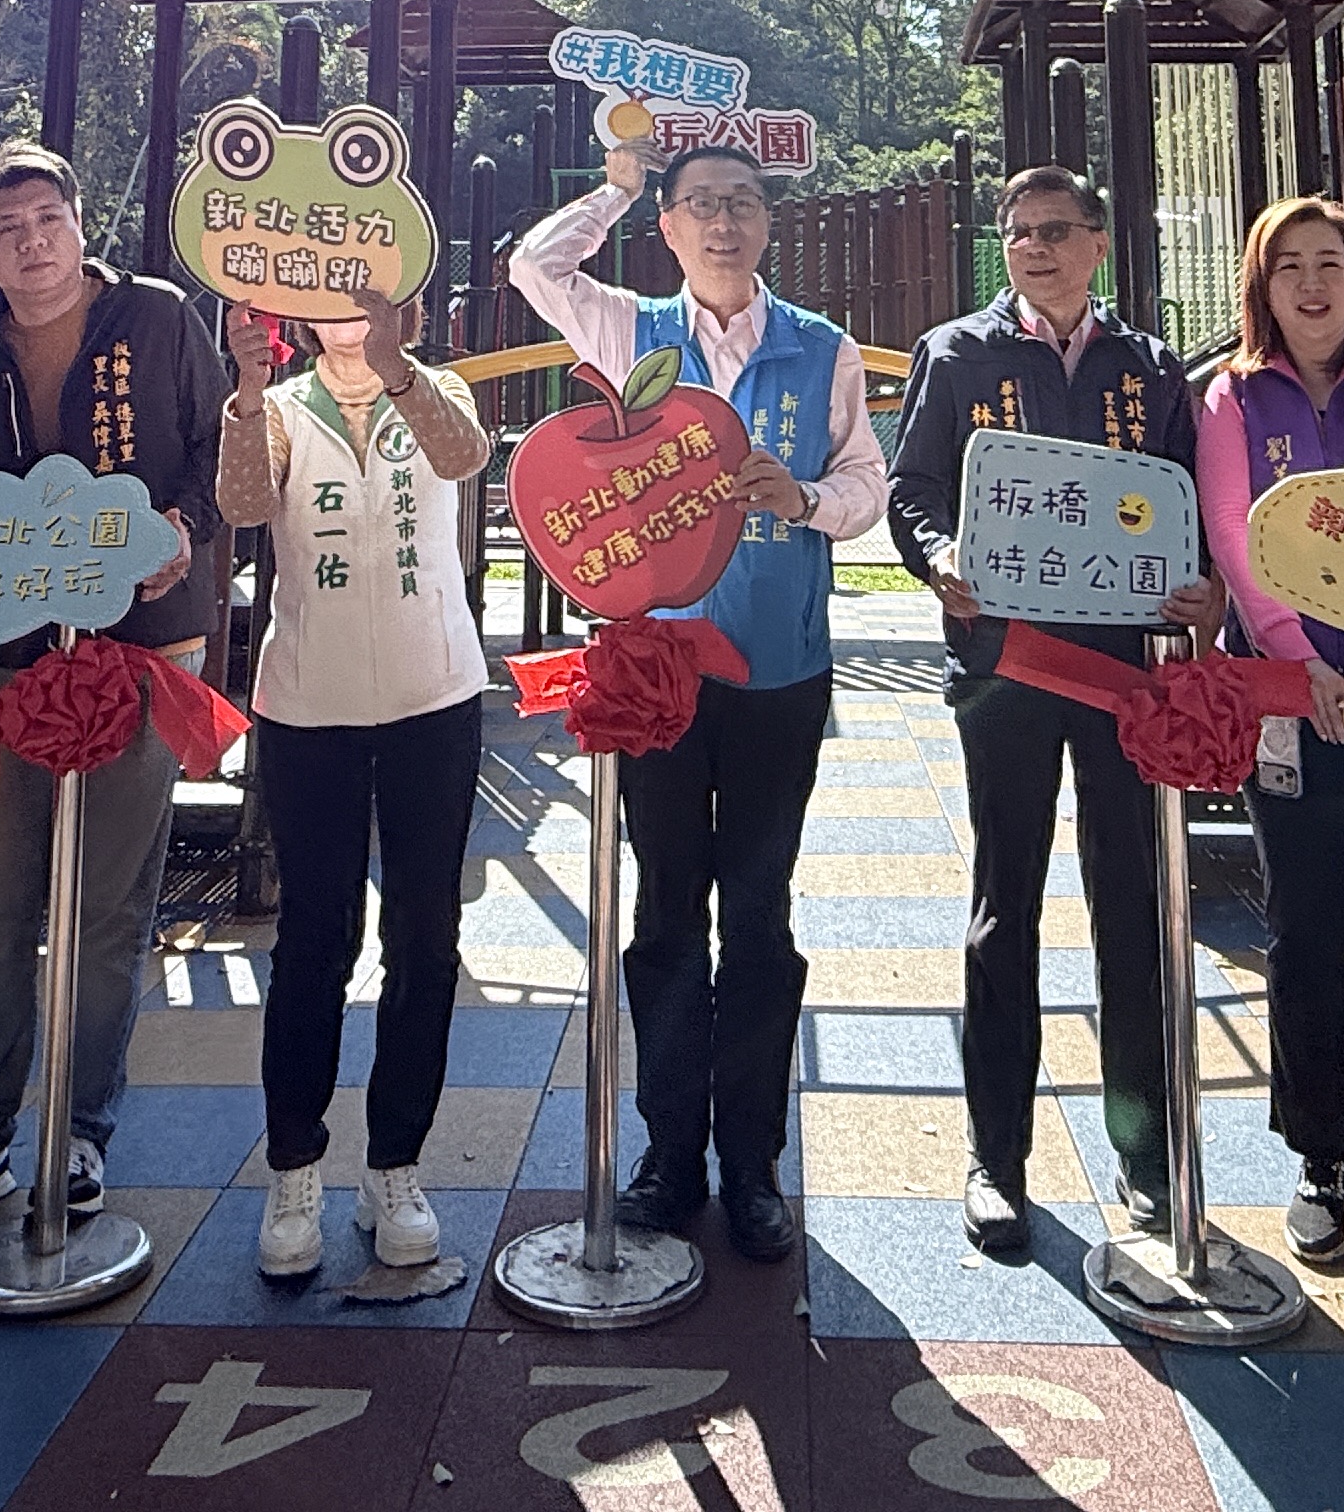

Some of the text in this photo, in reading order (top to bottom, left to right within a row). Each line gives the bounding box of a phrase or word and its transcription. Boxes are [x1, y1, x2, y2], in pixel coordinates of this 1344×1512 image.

[561, 36, 737, 107] #我想要
[654, 114, 807, 165] 玩公園
[204, 189, 395, 246] 新北活力
[223, 243, 372, 291] 蹦蹦跳
[312, 481, 351, 590] 石一佑
[389, 468, 420, 599] 新北市議員
[544, 420, 719, 544] 新北動健康
[572, 471, 737, 587] 健康你我他
[989, 478, 1089, 528] 板橋
[987, 545, 1169, 597] 特色公園
[147, 1360, 373, 1477] 4
[519, 1364, 731, 1488] 2
[889, 1373, 1111, 1500] 3
